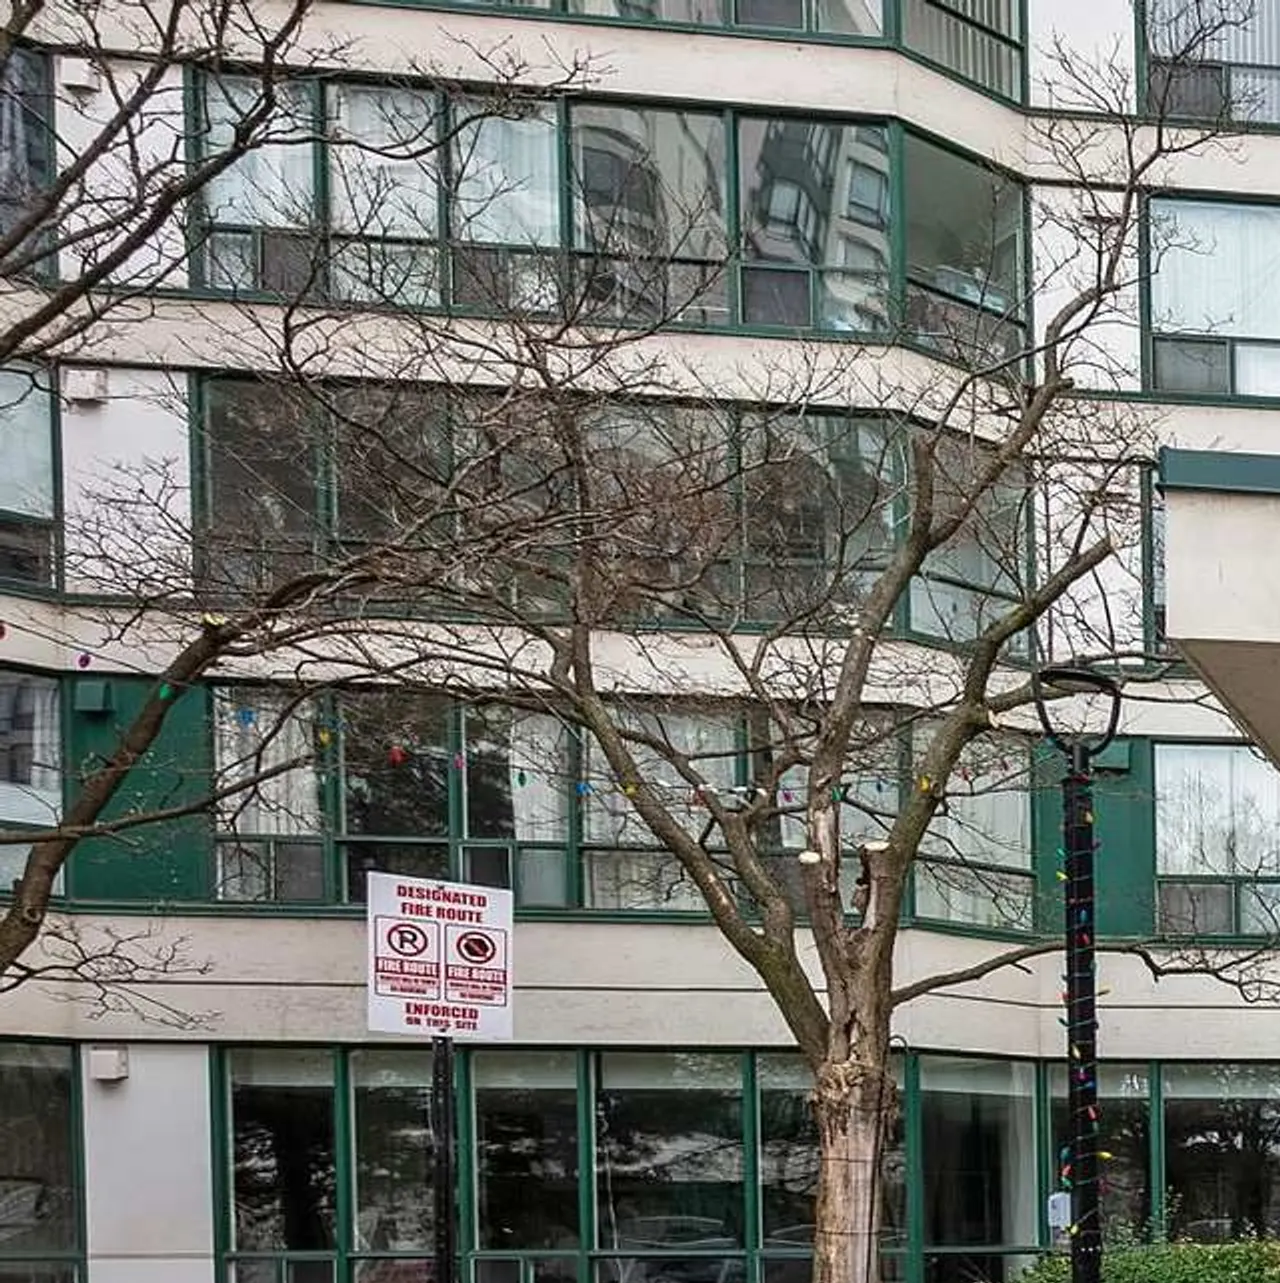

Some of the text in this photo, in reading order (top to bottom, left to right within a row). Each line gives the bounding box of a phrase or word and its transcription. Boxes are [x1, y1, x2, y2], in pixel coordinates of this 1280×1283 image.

[397, 884, 487, 908] DESIGNATED
[401, 902, 484, 923] FIRE ROUTE
[378, 959, 401, 973] FIRE
[405, 1002, 479, 1020] ENFORCED
[406, 1017, 478, 1030] ON THIS SITE
